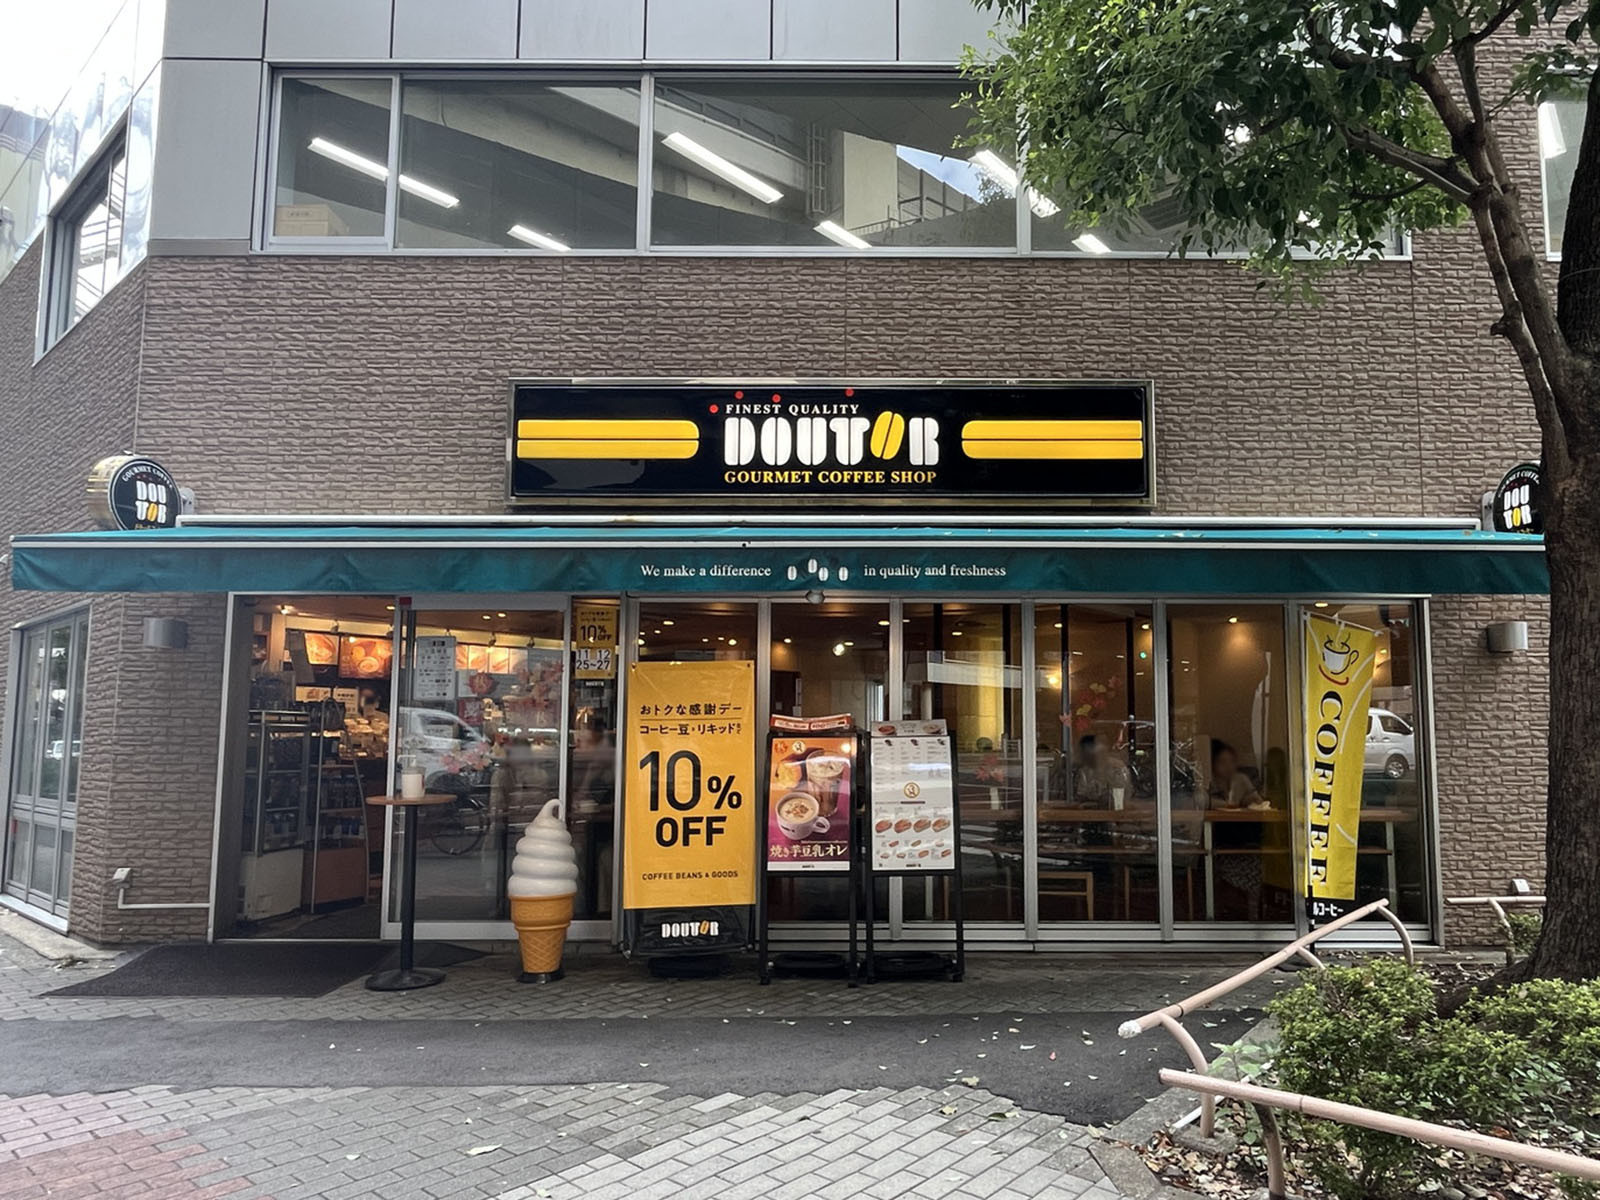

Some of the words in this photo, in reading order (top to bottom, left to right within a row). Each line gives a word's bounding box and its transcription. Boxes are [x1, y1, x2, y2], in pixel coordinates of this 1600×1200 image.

[725, 404, 782, 415] FINEST
[788, 404, 860, 416] QUALITY
[724, 411, 940, 466] DOUTOR
[724, 470, 813, 484] GOURMET
[817, 470, 886, 484] COFFEE
[890, 470, 937, 484] SHOP
[640, 565, 661, 576] We
[664, 565, 696, 576] make
[699, 567, 706, 576] a
[709, 564, 772, 576] difference
[864, 564, 876, 576] in
[879, 564, 922, 579] quality
[924, 564, 946, 576] and
[949, 564, 1007, 576] freshness
[598, 650, 610, 660] 12
[640, 703, 742, 716] おトクな感謝デー
[639, 750, 742, 811] 10%
[1310, 690, 1343, 885] COFFEE
[655, 816, 727, 847] OFF
[769, 844, 848, 858] 焼き芋豆乳オレ
[642, 872, 673, 881] COFFEE
[675, 871, 703, 880] BEANS
[711, 870, 738, 878] GOODS
[661, 920, 719, 938] DOUTOR
